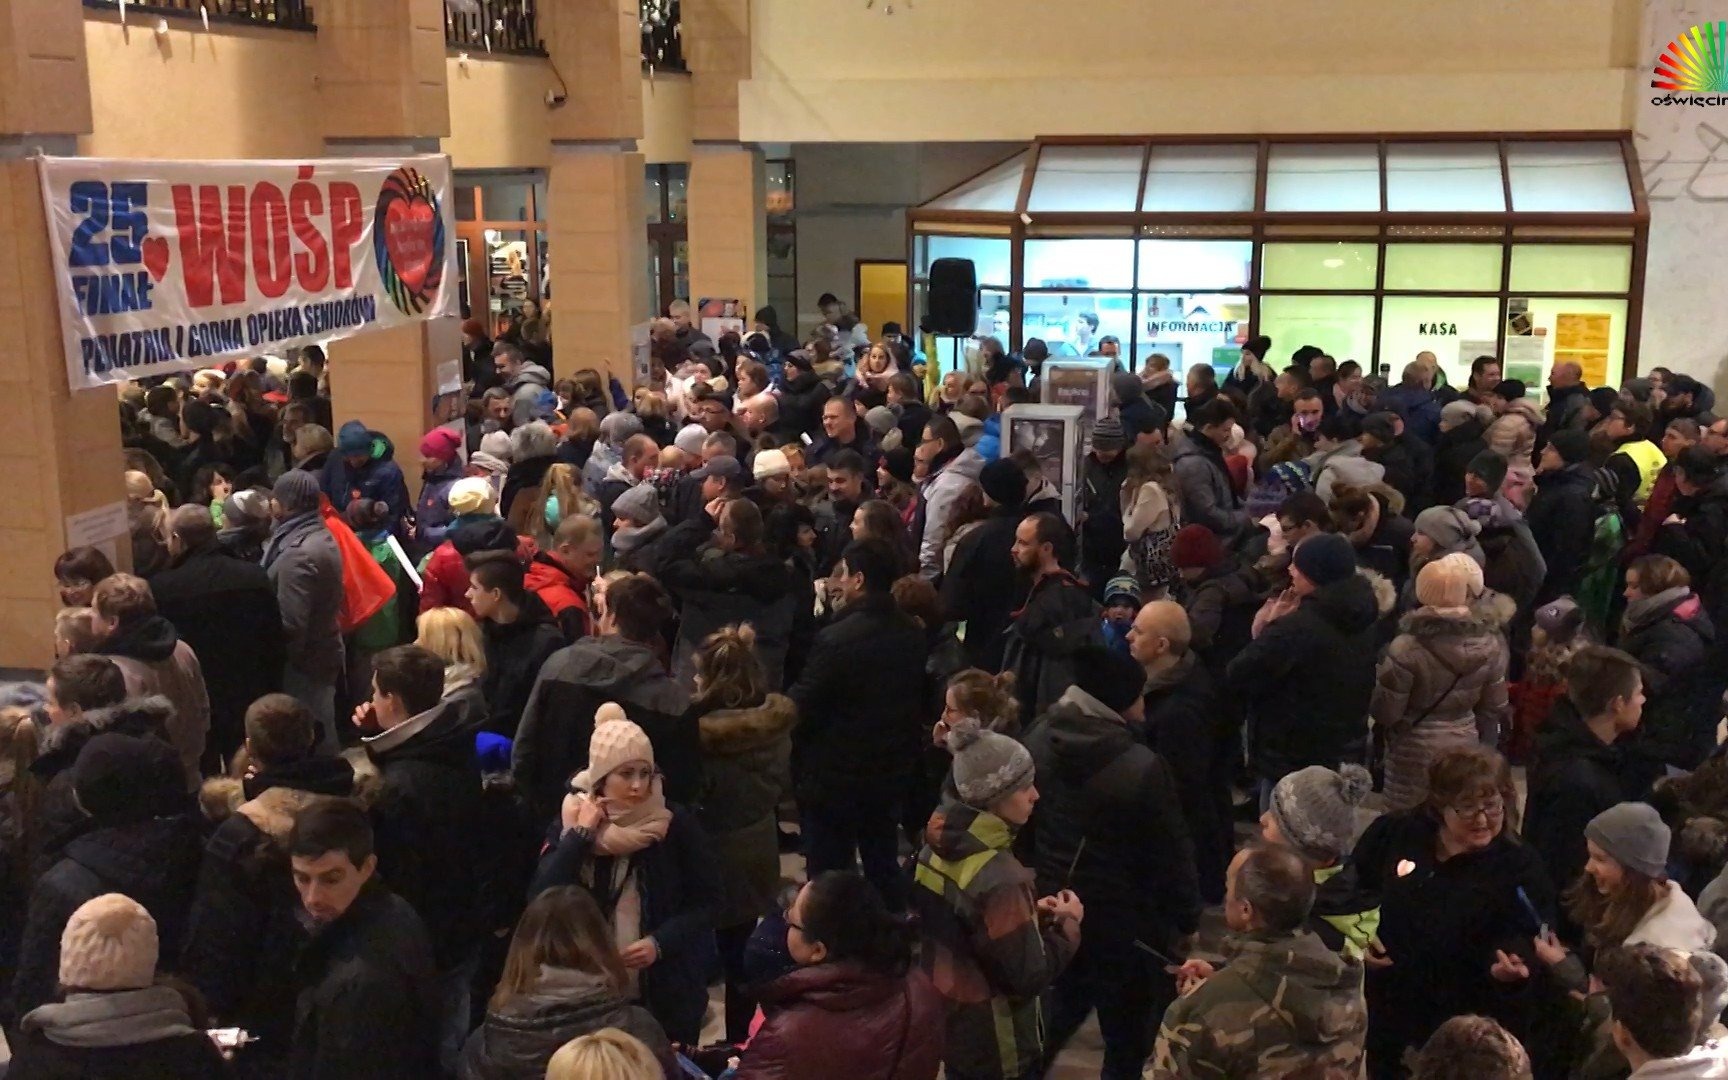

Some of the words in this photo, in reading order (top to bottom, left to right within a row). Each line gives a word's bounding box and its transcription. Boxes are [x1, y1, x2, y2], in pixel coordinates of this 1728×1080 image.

[69, 181, 148, 267] 25
[171, 165, 363, 307] WOŚP
[72, 271, 154, 315] FINAŁ
[176, 325, 183, 357] I
[188, 317, 244, 357] GODNA
[247, 306, 304, 346] OPIEKA
[304, 291, 376, 337] SENIORÓW
[1147, 321, 1233, 332] INFORMACJA
[1419, 321, 1457, 336] KASA
